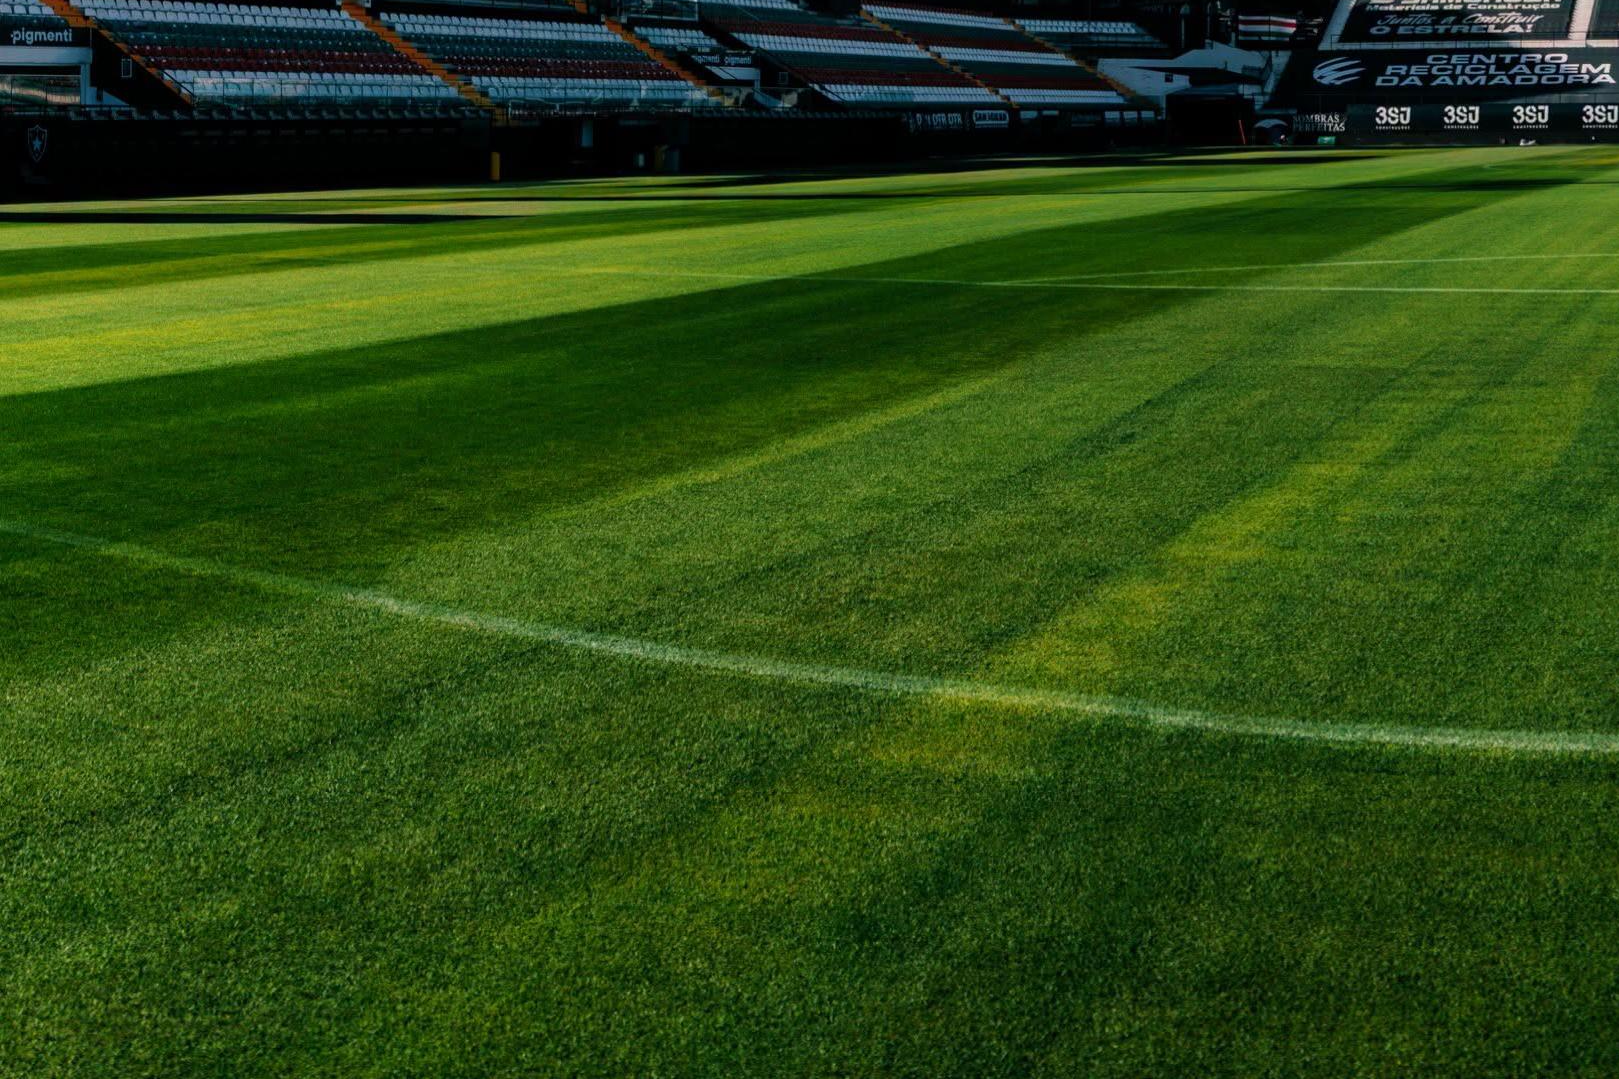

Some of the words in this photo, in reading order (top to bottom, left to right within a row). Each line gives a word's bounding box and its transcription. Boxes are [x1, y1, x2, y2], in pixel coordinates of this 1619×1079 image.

[1443, 3, 1462, 11] de
[1467, 3, 1561, 11] Construção
[12, 27, 73, 45] pigmenti
[1369, 25, 1388, 35] O
[1397, 24, 1534, 34] ESTRELA!
[1426, 53, 1569, 64] CENTRO
[1385, 63, 1612, 75] RECICLAGEM
[1375, 75, 1424, 86] DA
[1425, 74, 1616, 86] AMADORA
[1376, 107, 1410, 124] 3SJ
[1444, 106, 1479, 123] 3SJ
[1513, 105, 1548, 123] 3SJ
[1583, 105, 1618, 123] 3SJ
